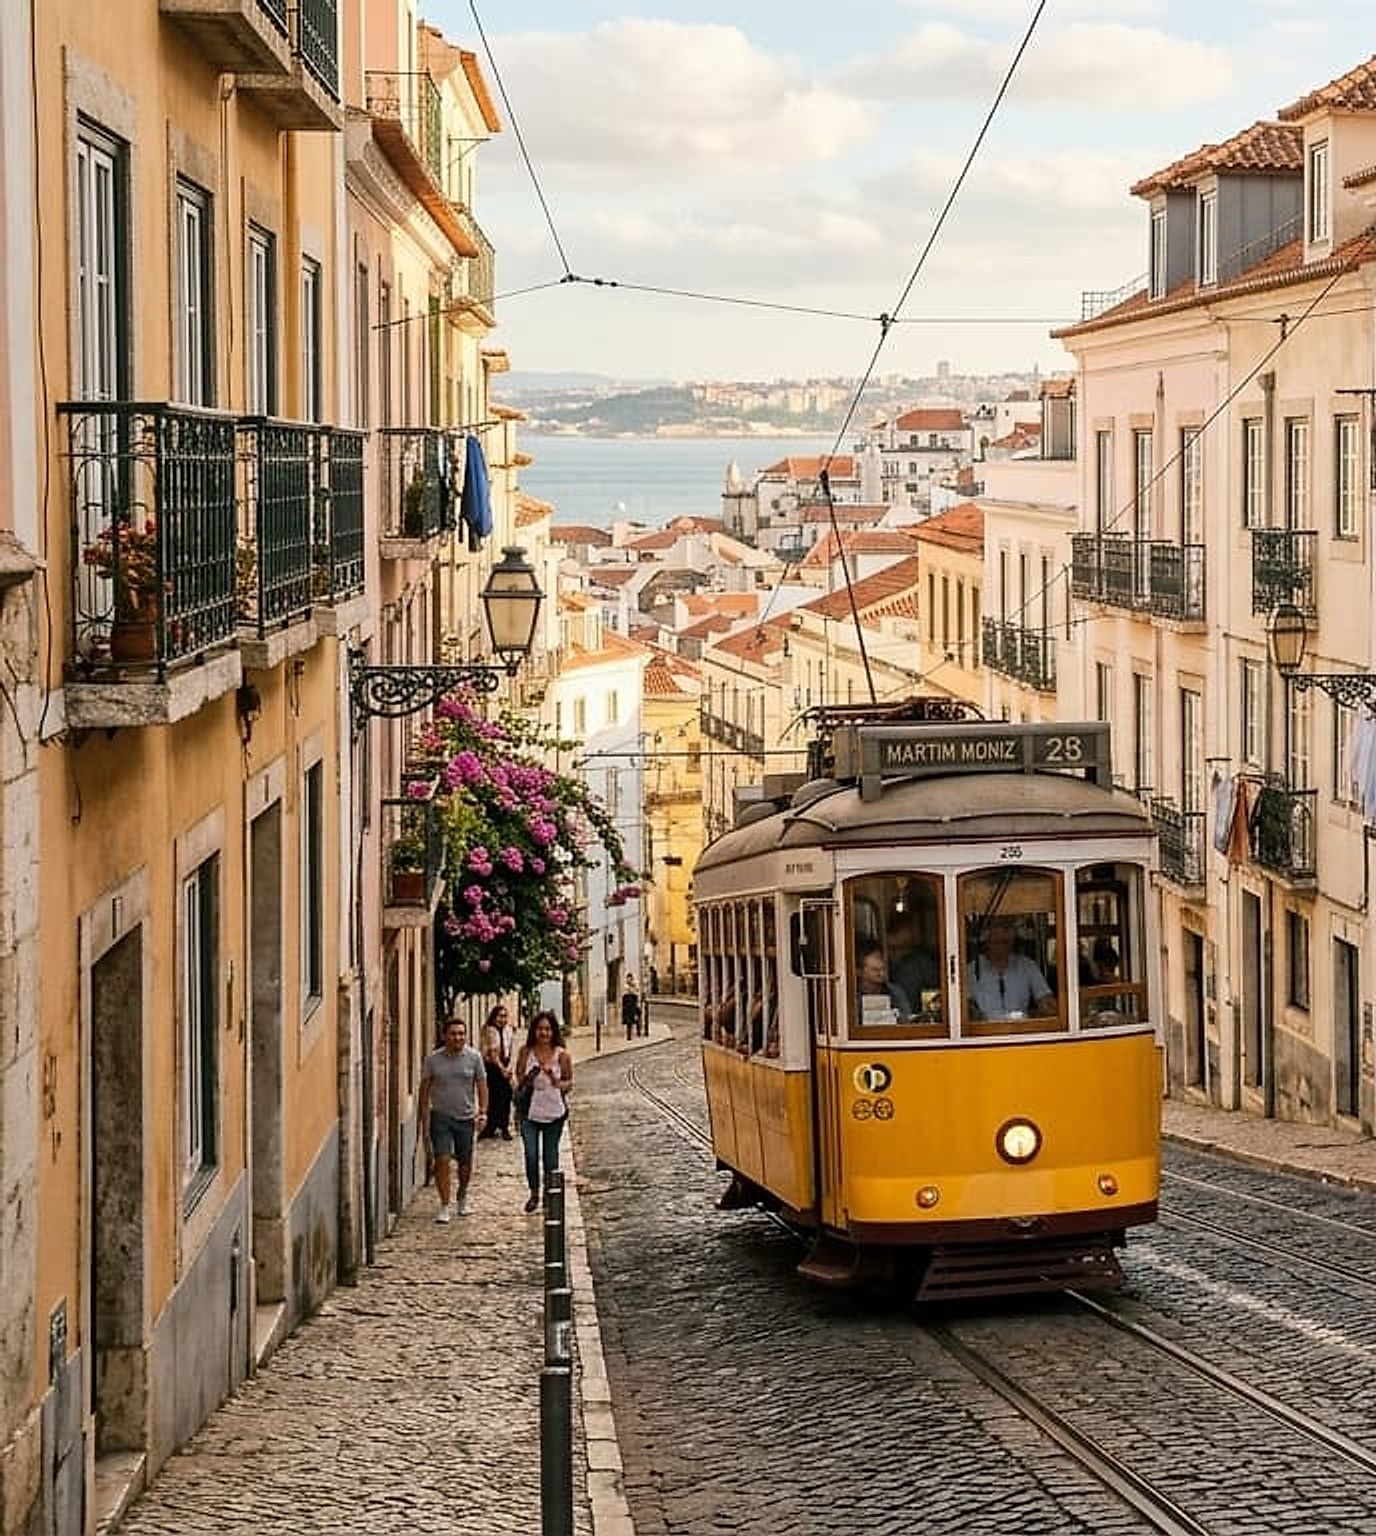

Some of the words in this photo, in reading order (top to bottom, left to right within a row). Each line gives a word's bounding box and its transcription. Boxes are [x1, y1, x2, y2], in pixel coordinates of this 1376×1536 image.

[887, 743, 955, 763] MARTIM
[961, 740, 1016, 760] MONIZ
[1046, 736, 1082, 761] 28
